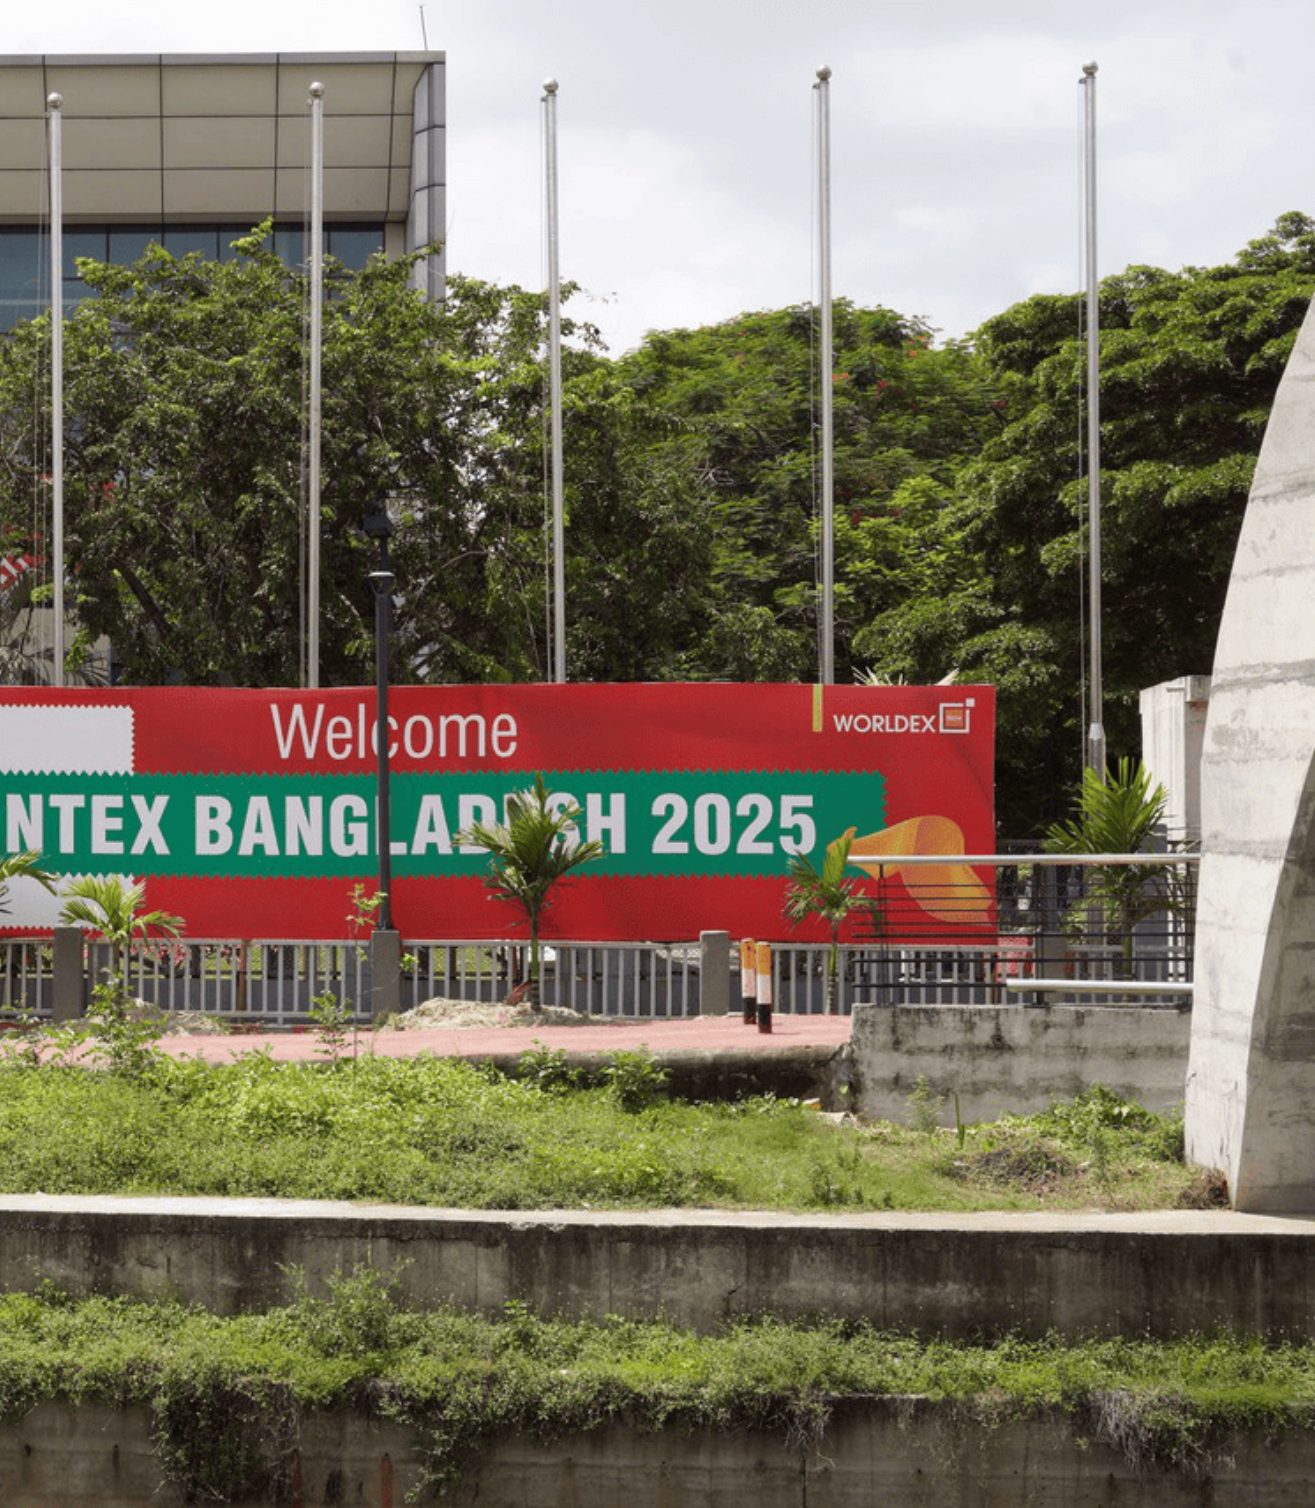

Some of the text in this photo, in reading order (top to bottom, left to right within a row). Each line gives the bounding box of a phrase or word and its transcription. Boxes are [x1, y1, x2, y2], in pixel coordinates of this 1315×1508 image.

[270, 702, 518, 760] Welcome
[833, 715, 936, 733] WORLDEX
[195, 793, 626, 856] BANGADSH
[651, 793, 817, 855] 2025
